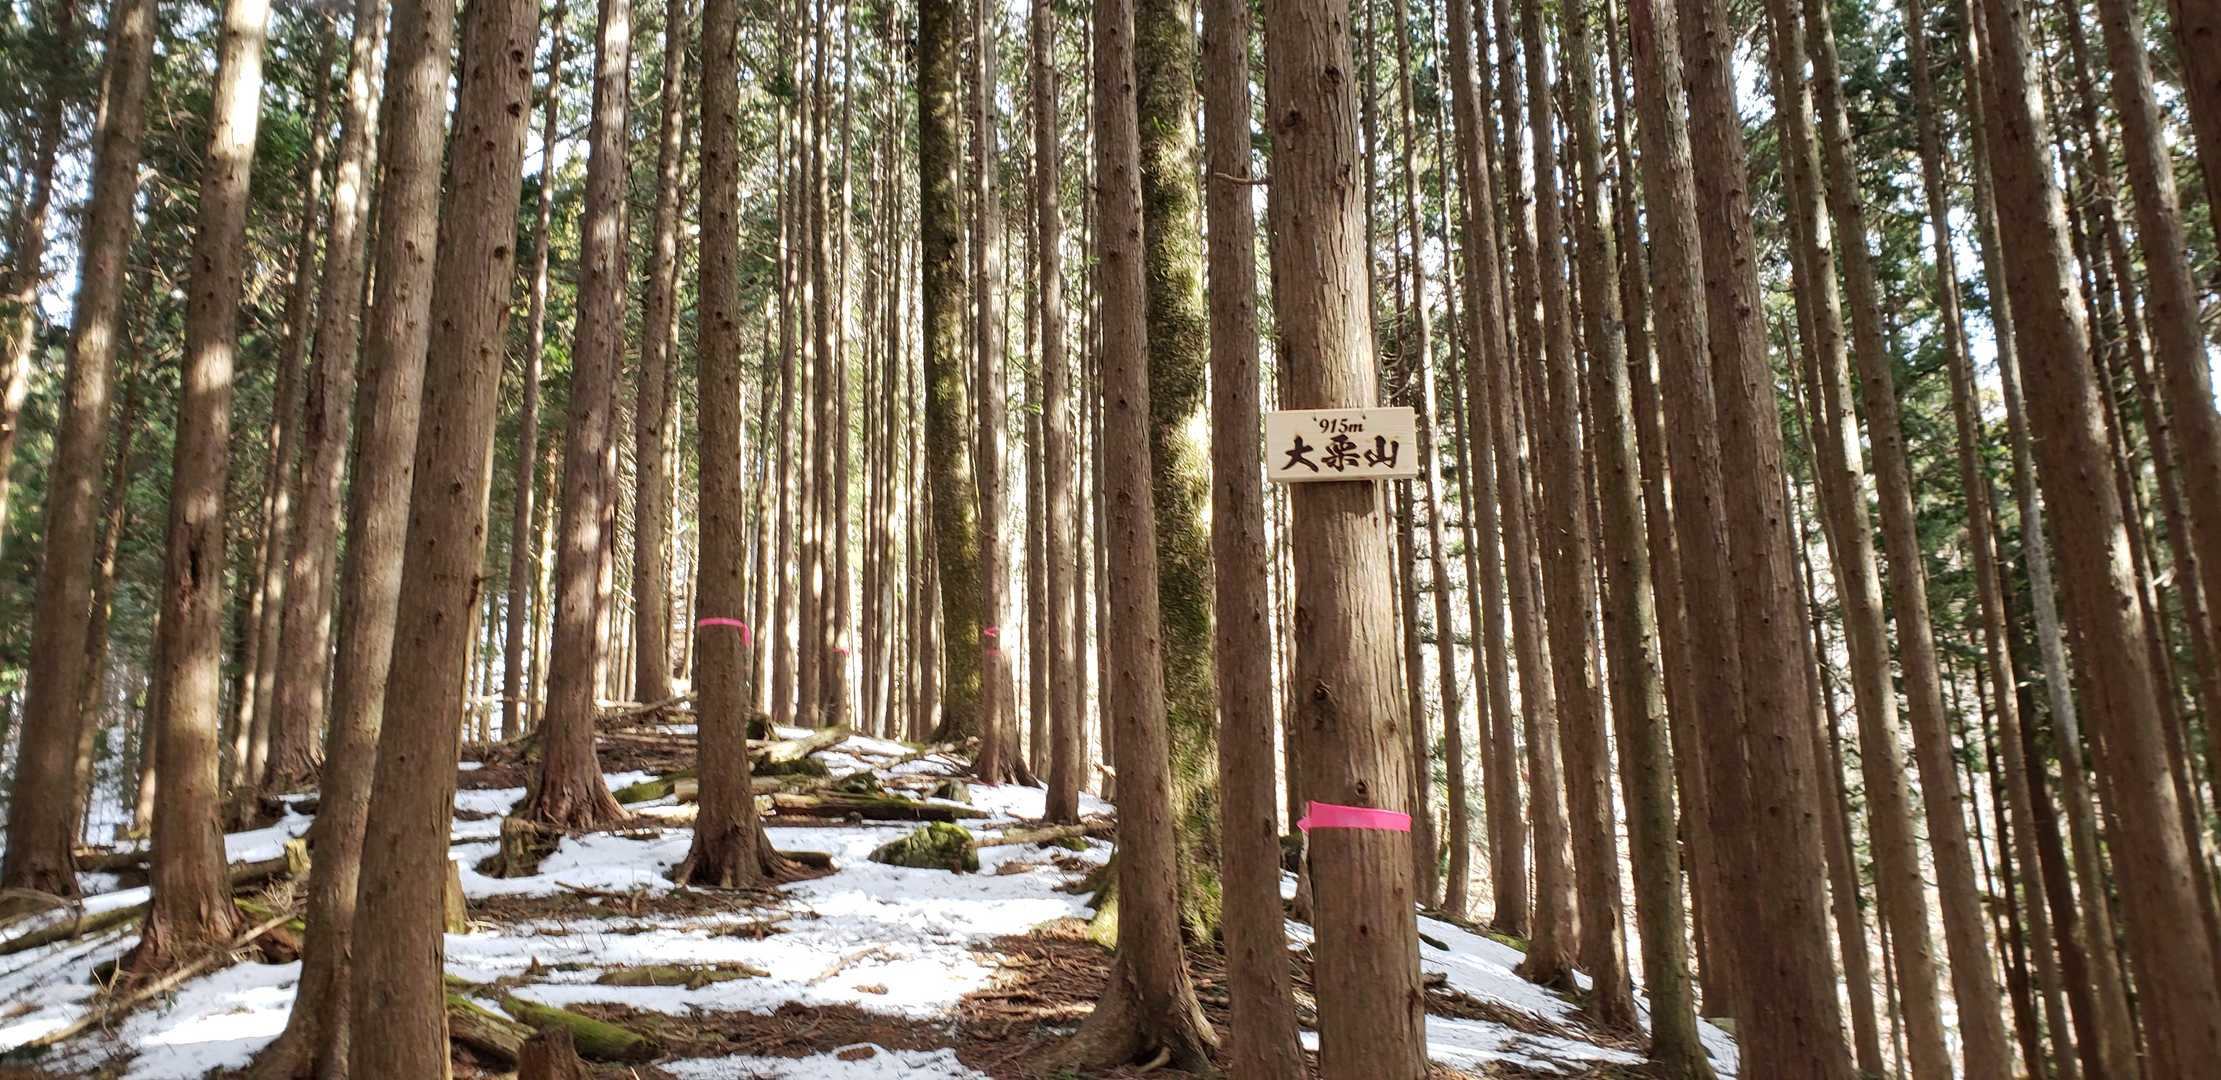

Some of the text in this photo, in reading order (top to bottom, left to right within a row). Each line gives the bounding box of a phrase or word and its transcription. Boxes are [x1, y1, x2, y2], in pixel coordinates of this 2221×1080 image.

[1319, 418, 1363, 433] 915m
[1281, 434, 1399, 472] 大栗山
